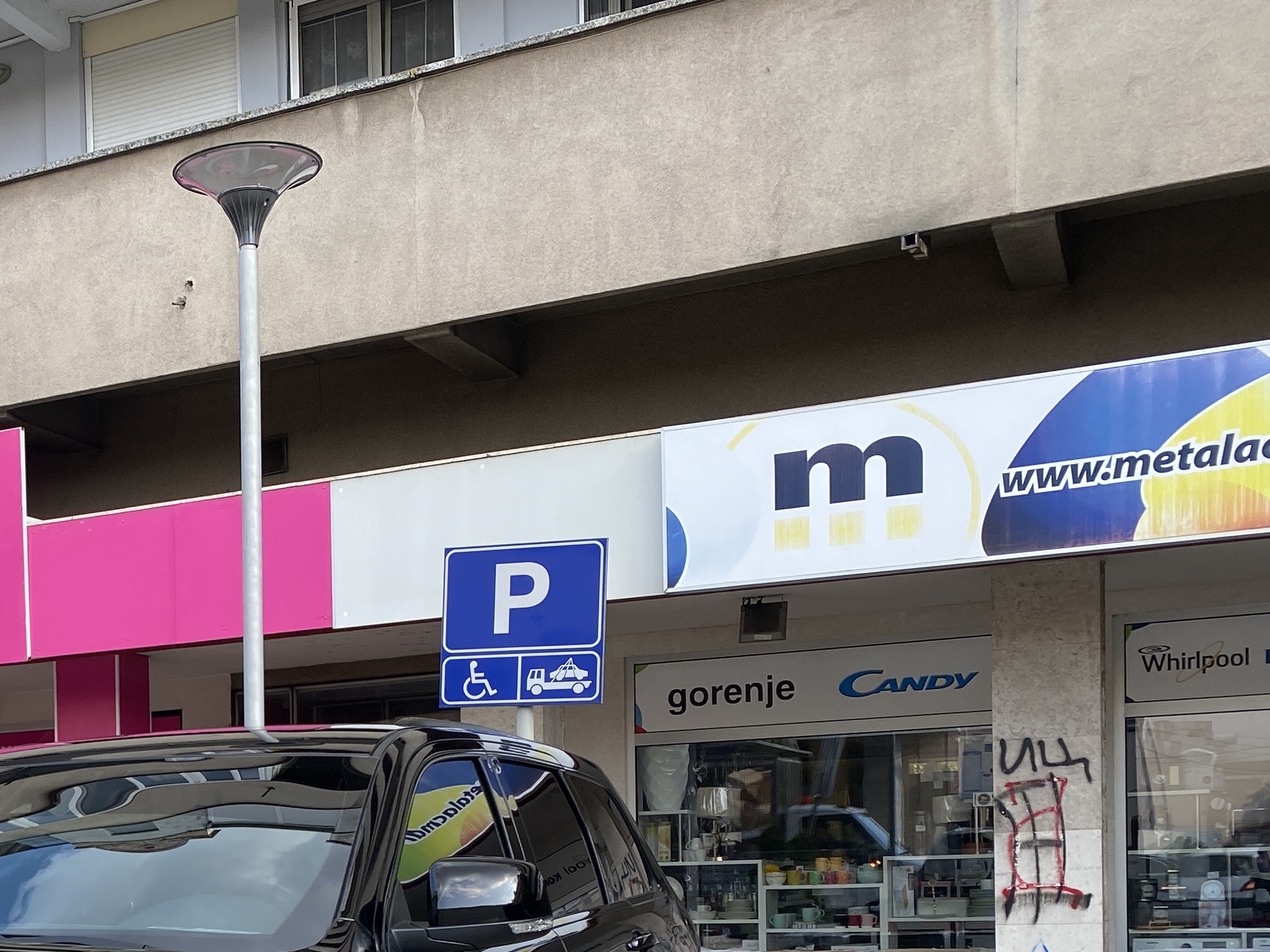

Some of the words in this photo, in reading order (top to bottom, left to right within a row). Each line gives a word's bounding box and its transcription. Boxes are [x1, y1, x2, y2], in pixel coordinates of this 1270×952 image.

[493, 561, 550, 635] P
[1141, 647, 1250, 674] Whirlpool
[667, 674, 796, 716] gorenje
